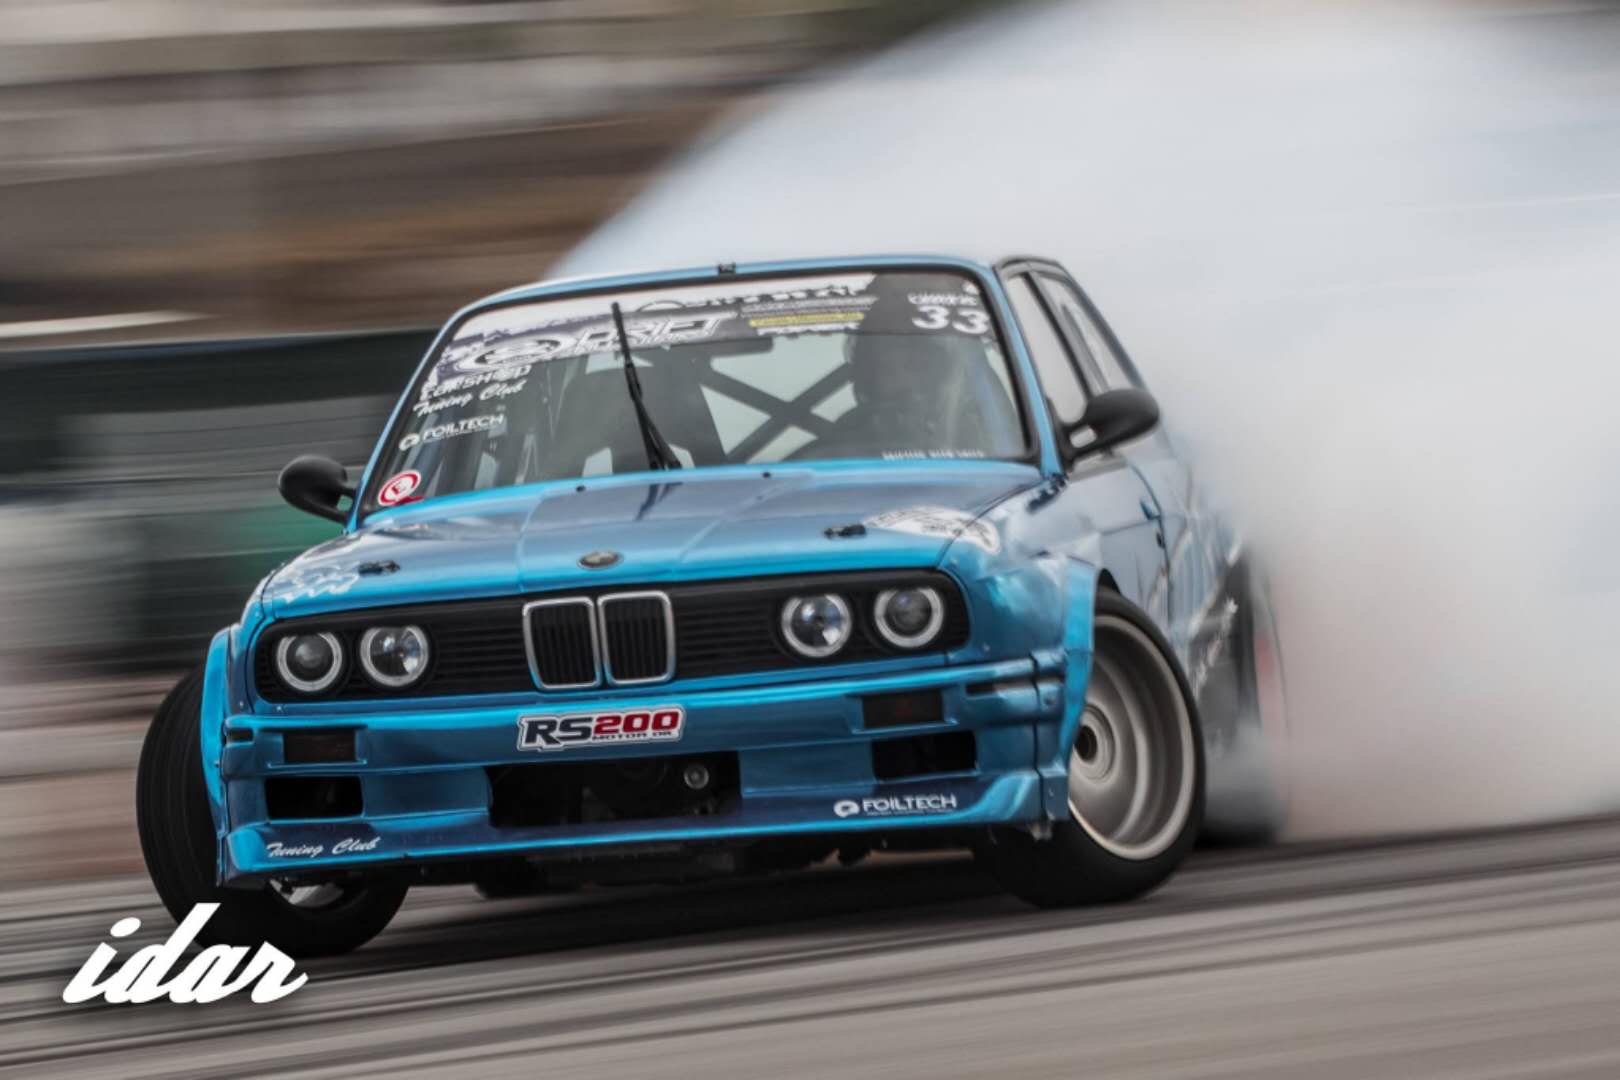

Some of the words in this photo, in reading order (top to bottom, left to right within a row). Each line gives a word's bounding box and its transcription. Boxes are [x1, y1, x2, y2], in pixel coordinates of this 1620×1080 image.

[911, 305, 990, 335] 33
[423, 414, 504, 440] FOILTECH
[524, 711, 679, 745] RS200
[862, 793, 957, 812] FOILTECH
[266, 841, 324, 858] Tuning
[332, 836, 381, 855] Club
